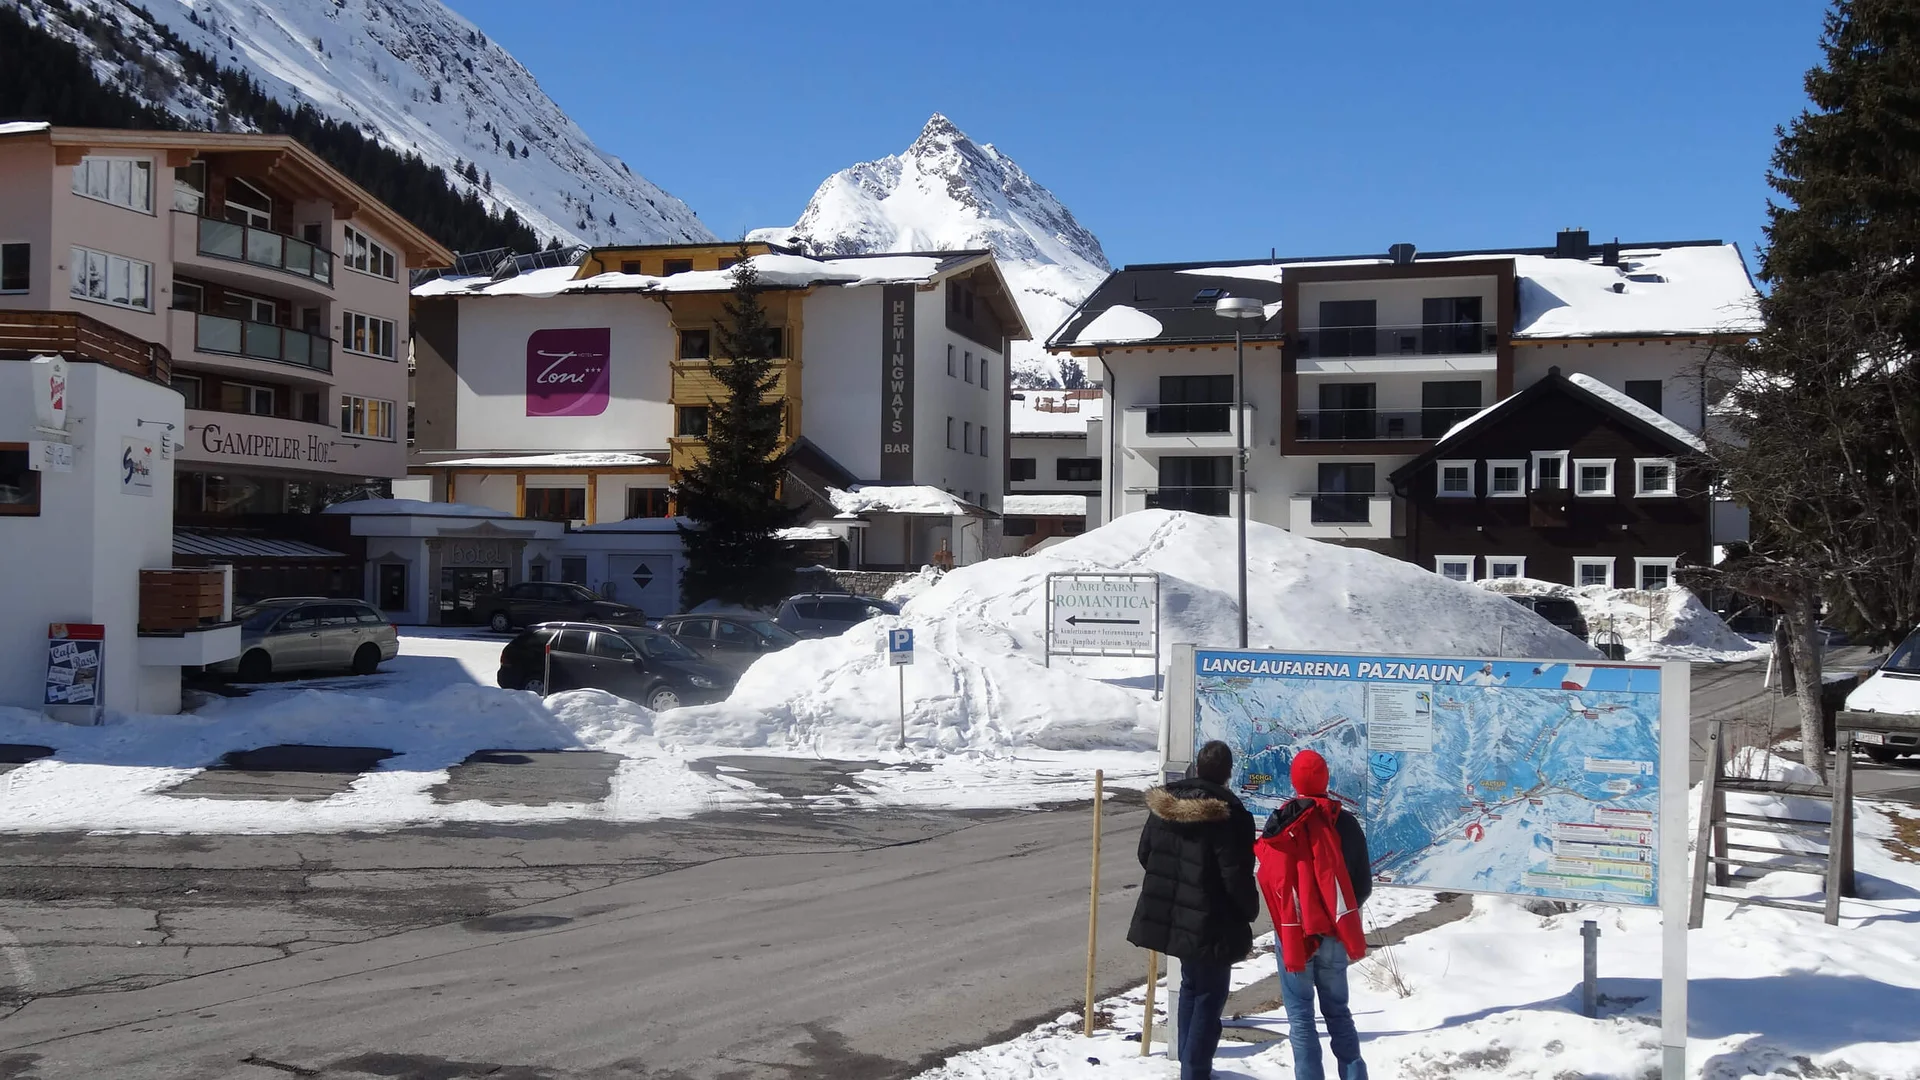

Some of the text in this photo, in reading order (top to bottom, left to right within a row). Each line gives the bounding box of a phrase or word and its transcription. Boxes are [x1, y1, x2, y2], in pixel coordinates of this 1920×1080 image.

[536, 350, 586, 384] Toni
[891, 300, 905, 433] HEMINGWAYS
[884, 443, 910, 454] BAR
[1069, 582, 1138, 593] APART GARNI
[1056, 594, 1150, 609] ROMANTICA
[894, 630, 910, 650] P
[53, 643, 76, 659] Café
[1202, 658, 1465, 683] LANGLAUFARENA PAZNAUN
